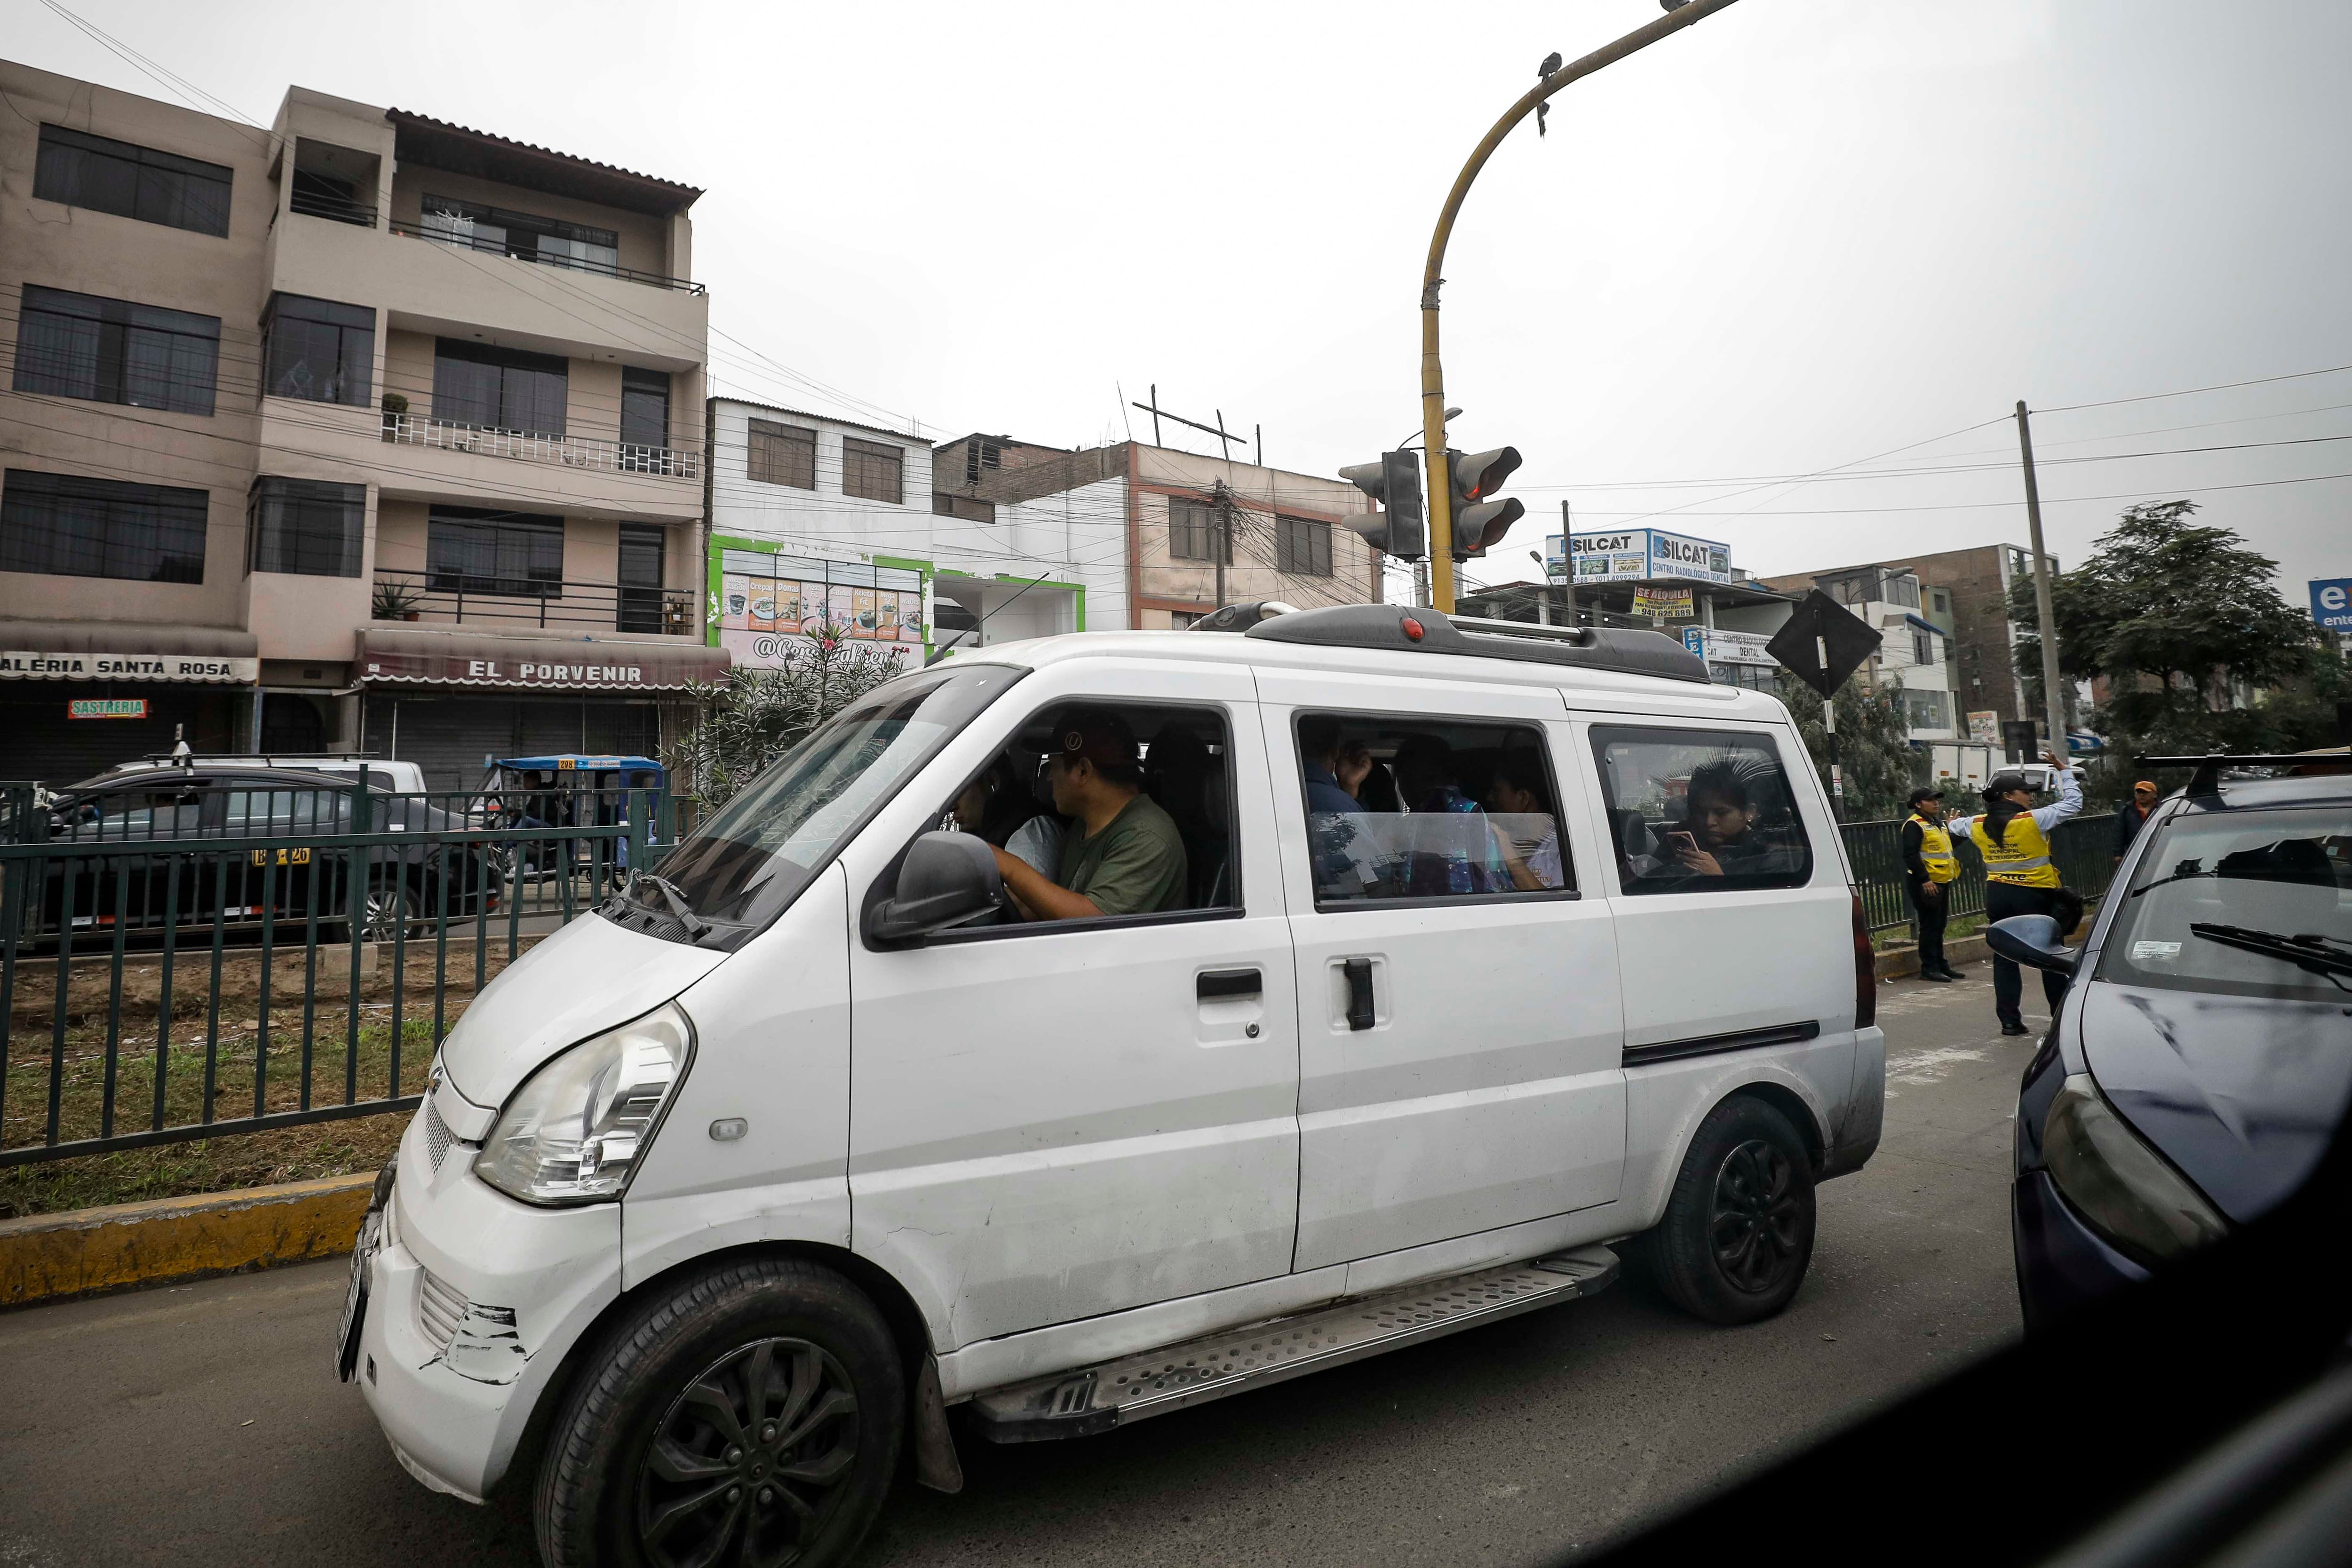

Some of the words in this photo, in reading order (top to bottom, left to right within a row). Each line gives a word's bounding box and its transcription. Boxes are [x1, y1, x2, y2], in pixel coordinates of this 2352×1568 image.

[1573, 536, 1631, 552] SILCAT
[1663, 539, 1708, 565] SILCAT
[1653, 562, 1674, 574] CENTRO
[1676, 566, 1709, 580] RADIOLÓGICO
[1711, 572, 1729, 583] DENTAL
[750, 582, 773, 592] Crepas
[778, 583, 799, 593] Donas
[854, 589, 874, 598] Kekito
[880, 592, 895, 600] Mega
[1637, 587, 1650, 598] SE
[1651, 589, 1690, 600] ALQUILA
[1642, 608, 1656, 617] 948
[1724, 634, 1742, 644] CENTRO
[1740, 647, 1759, 657] DENTAL
[97, 661, 165, 673] SANTA
[179, 662, 231, 675] ROSA
[469, 661, 501, 677] EL
[520, 664, 641, 682] PORVENIR
[72, 700, 143, 713] SASTRERIA
[560, 760, 572, 768] 208
